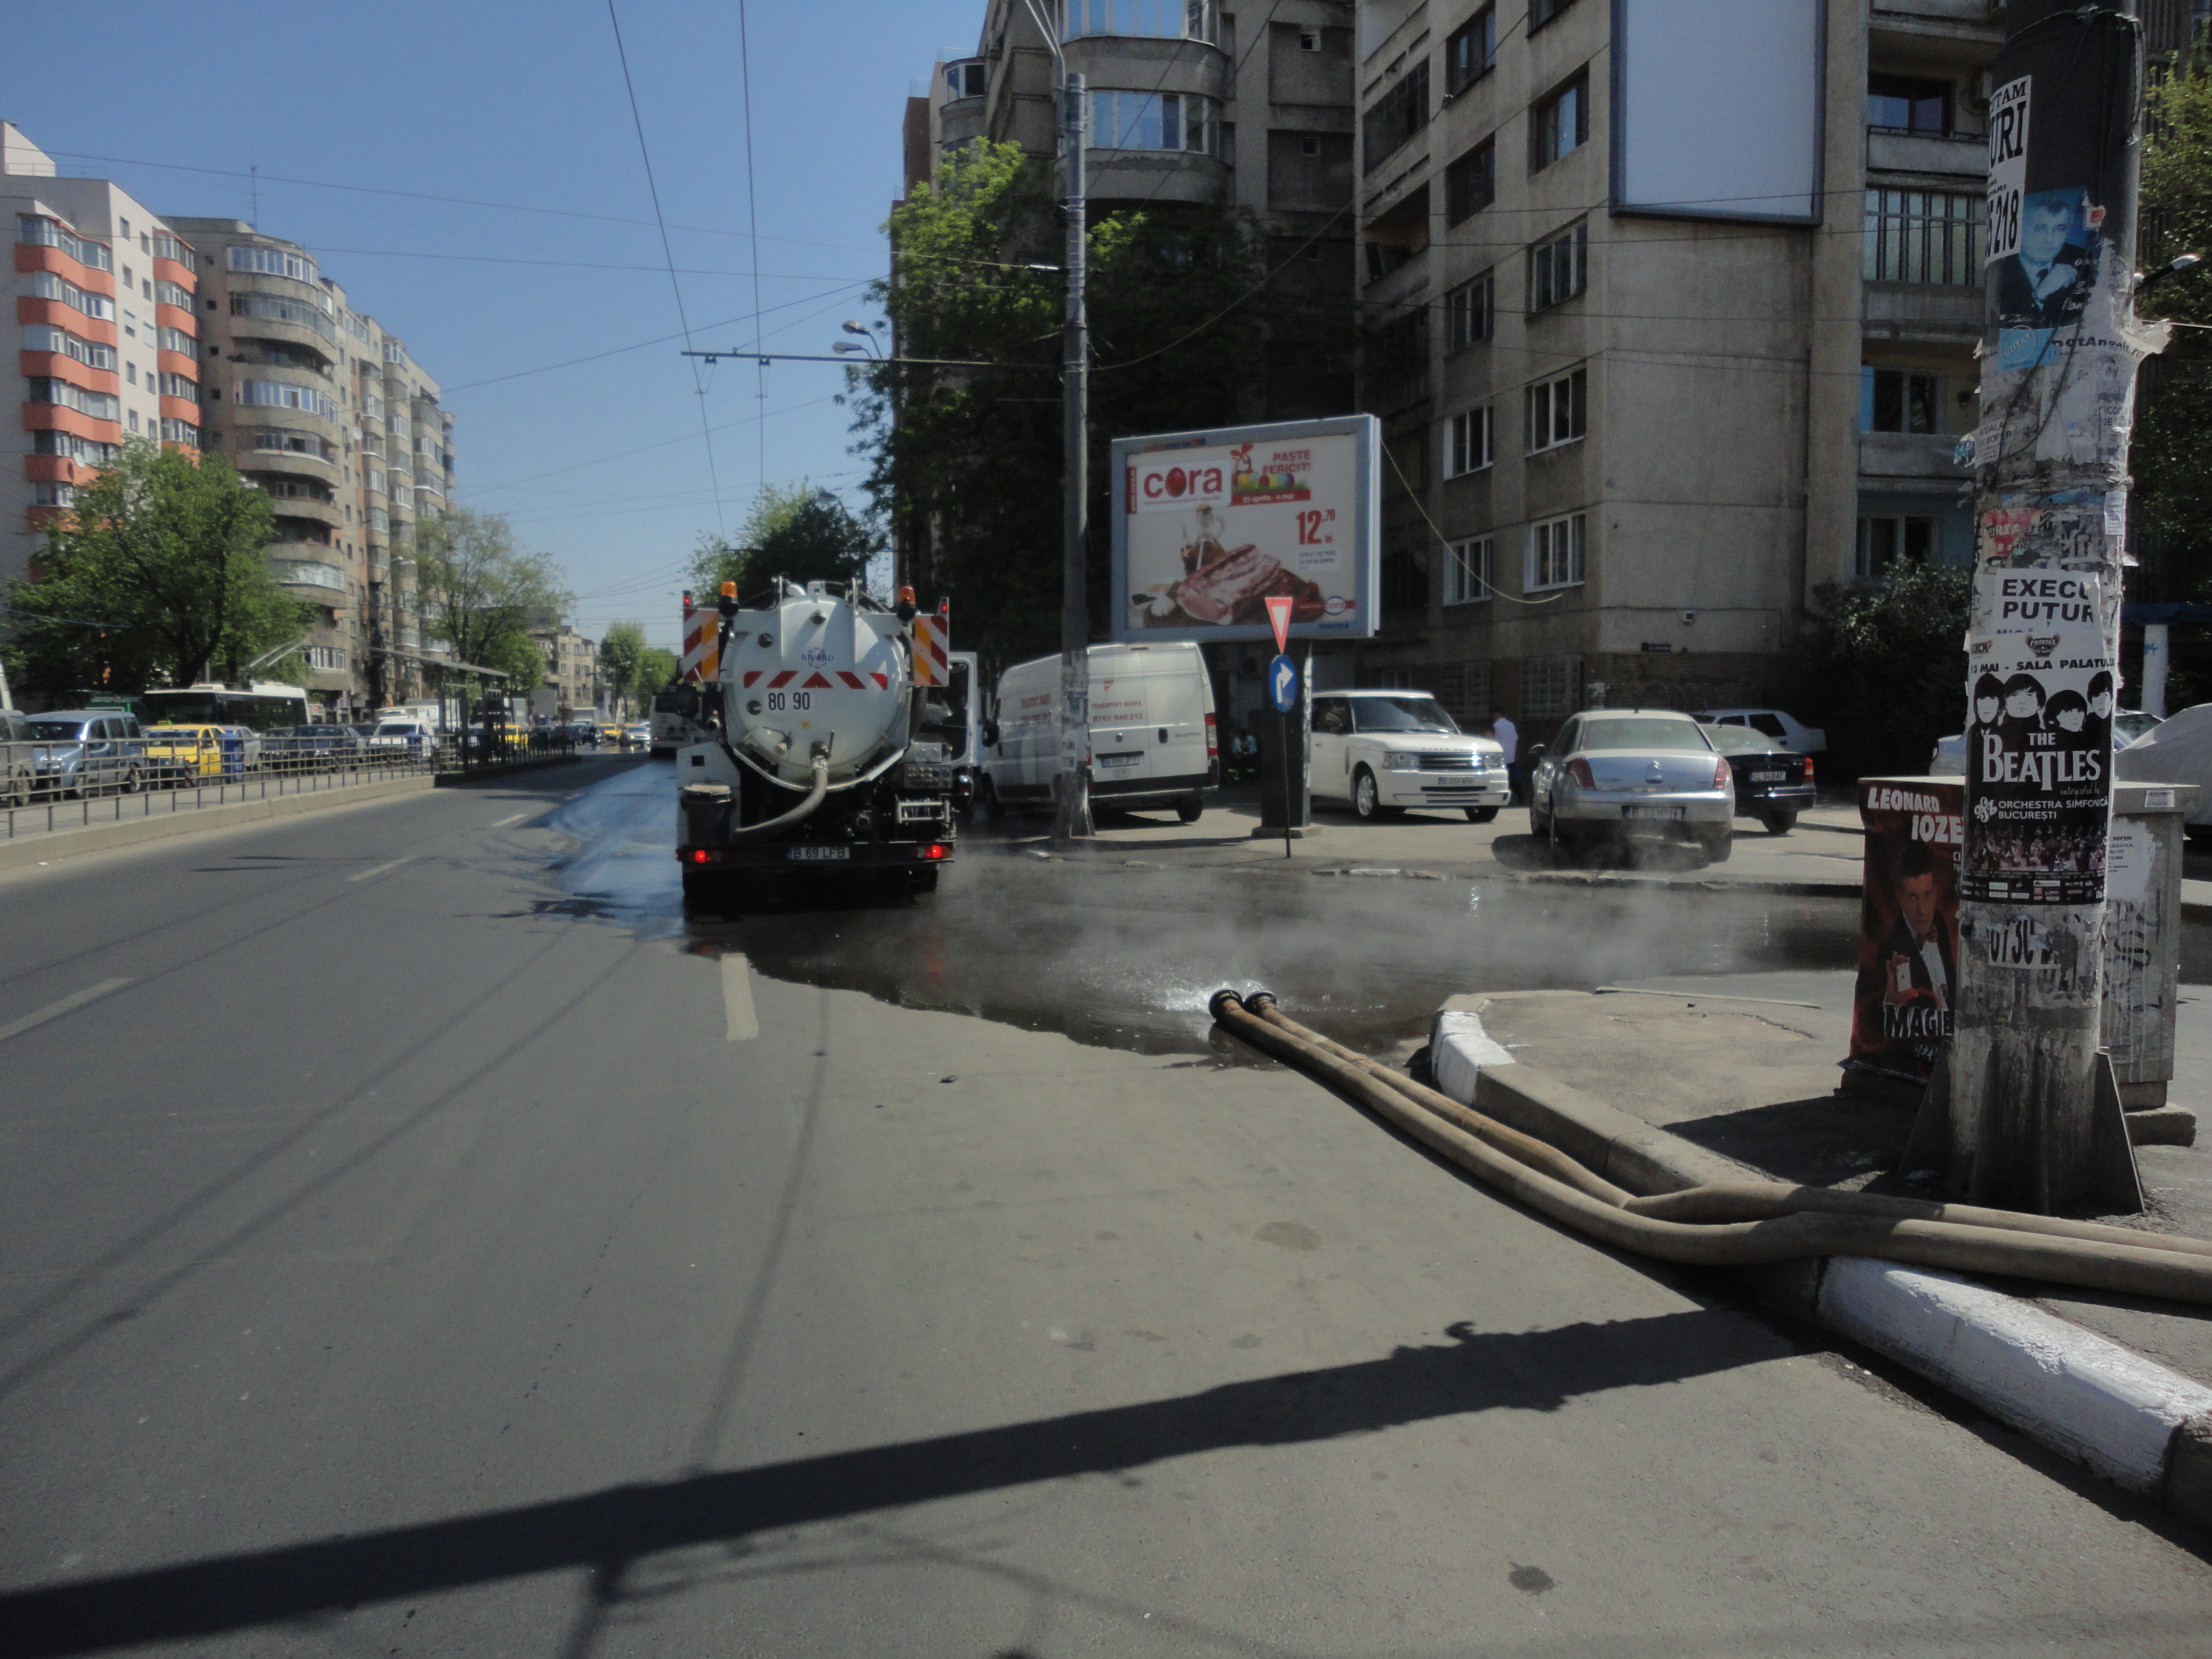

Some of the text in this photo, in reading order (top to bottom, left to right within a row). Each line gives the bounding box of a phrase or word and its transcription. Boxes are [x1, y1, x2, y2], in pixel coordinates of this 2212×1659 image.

[1144, 467, 1223, 499] cora
[1980, 663, 2000, 673] MAI
[2016, 661, 2053, 671] SALA
[768, 692, 811, 710] 80 90
[2028, 732, 2056, 746] THE
[1982, 734, 2100, 791] BEATLES
[1867, 786, 1941, 813] LEONARD
[1998, 800, 2062, 810] ORCHESTRA
[1911, 815, 1965, 844] IOZE
[794, 848, 801, 859] B
